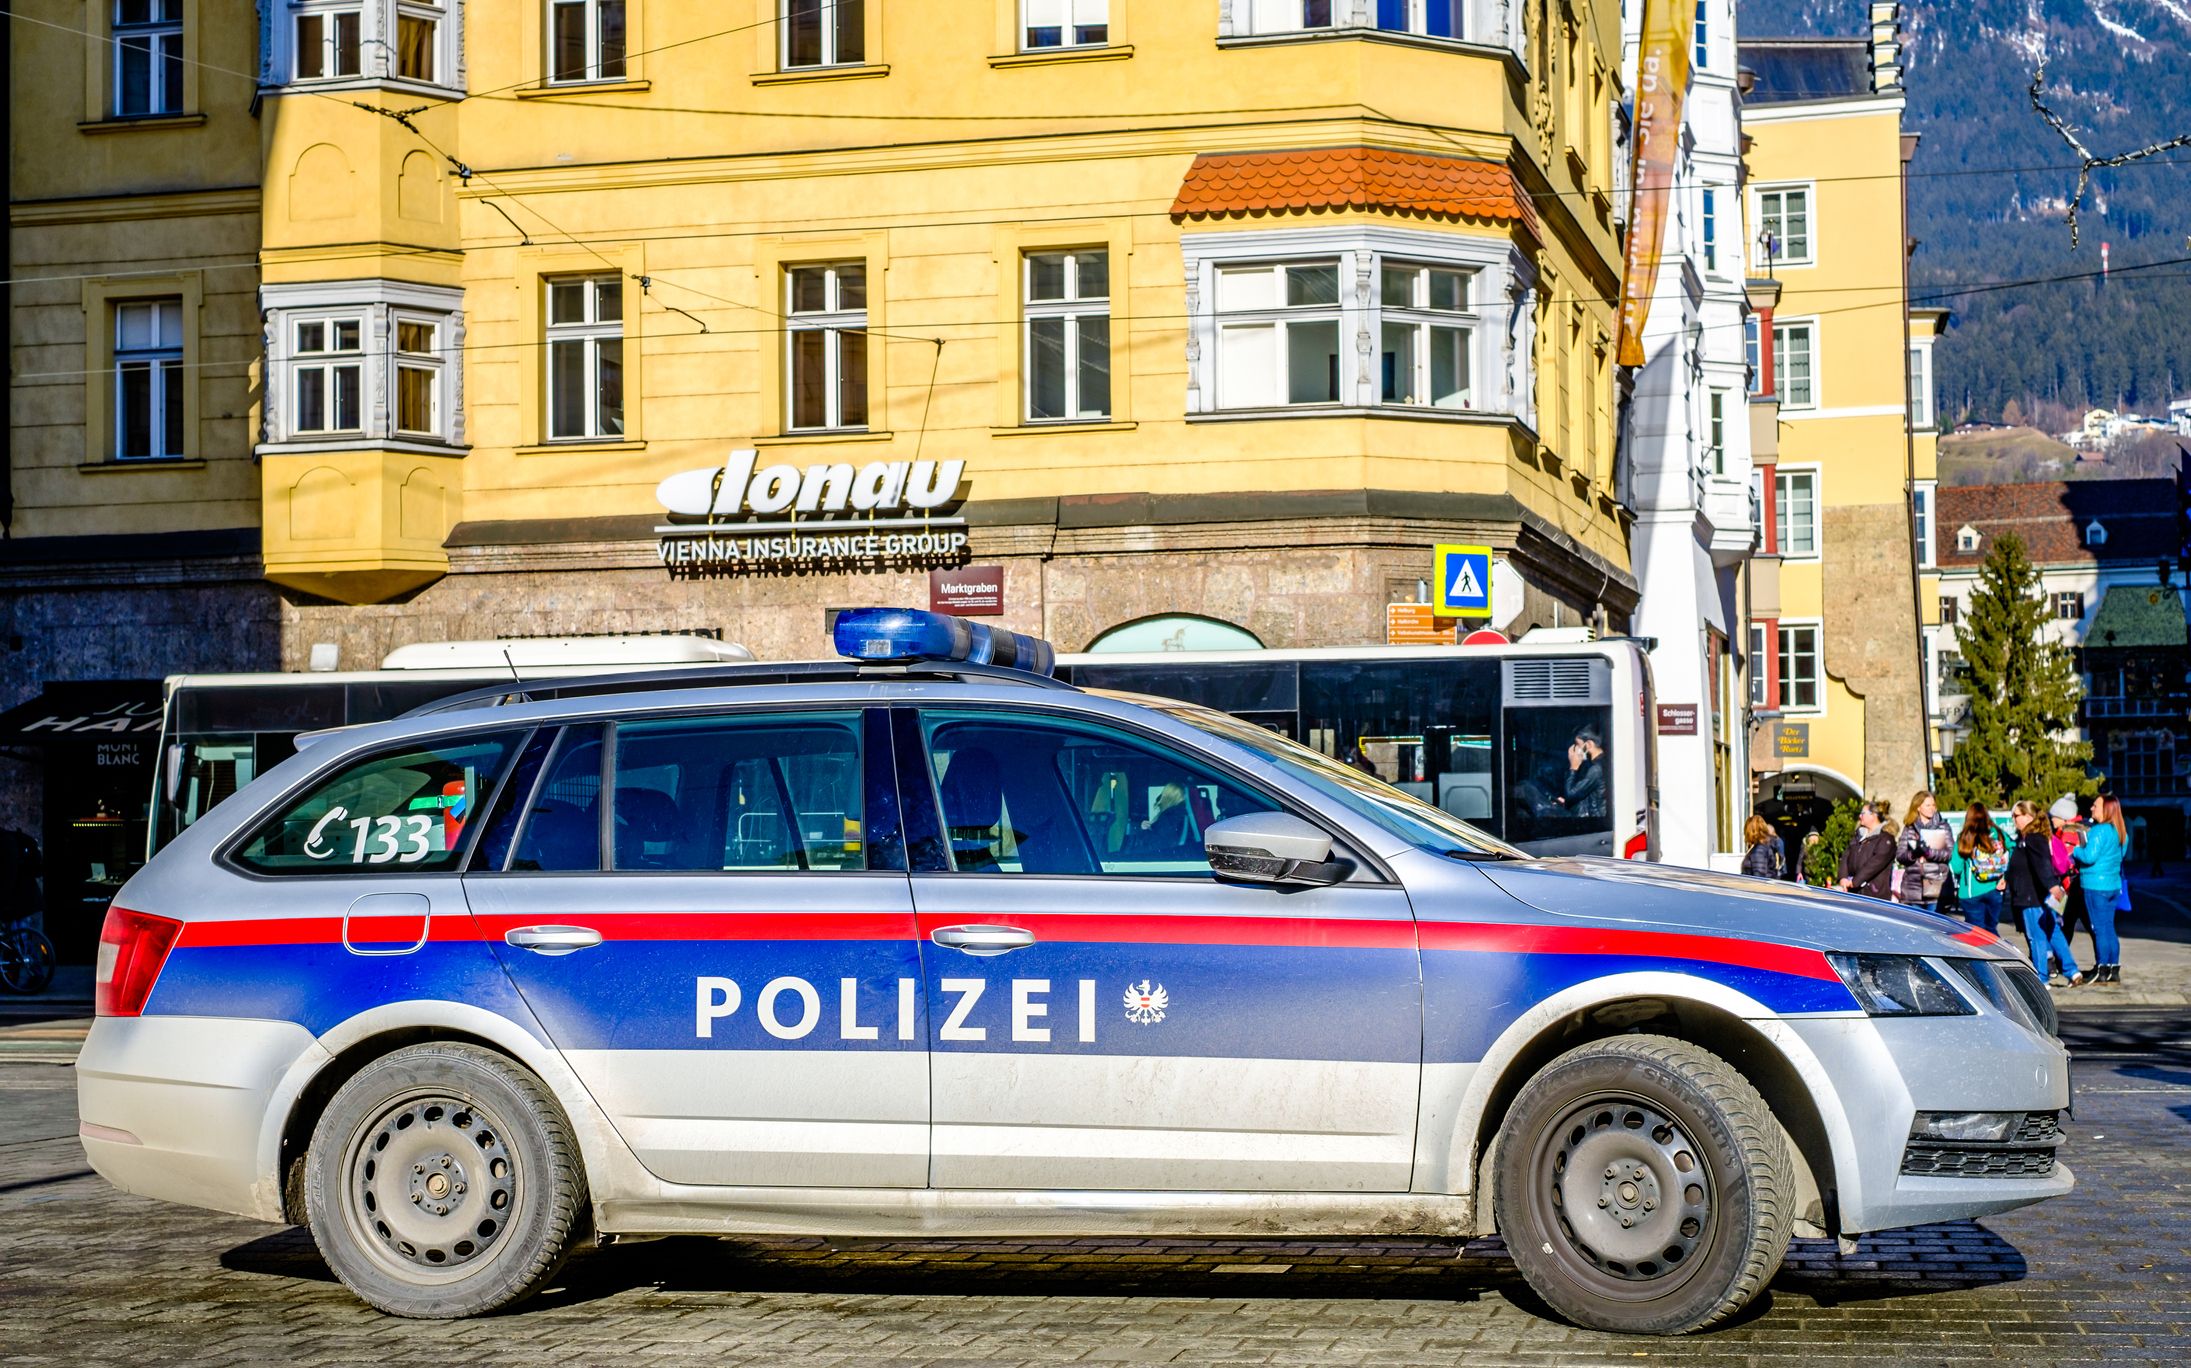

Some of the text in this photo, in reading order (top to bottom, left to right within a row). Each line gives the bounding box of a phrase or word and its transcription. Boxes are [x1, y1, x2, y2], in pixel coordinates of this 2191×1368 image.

[656, 449, 967, 515] donau
[656, 532, 967, 561] VIENNA INSURANCE GROUP
[941, 583, 998, 595] Marktgraben
[97, 753, 140, 765] BLANC
[351, 815, 432, 863] 133
[696, 976, 1096, 1042] POLIZEI
